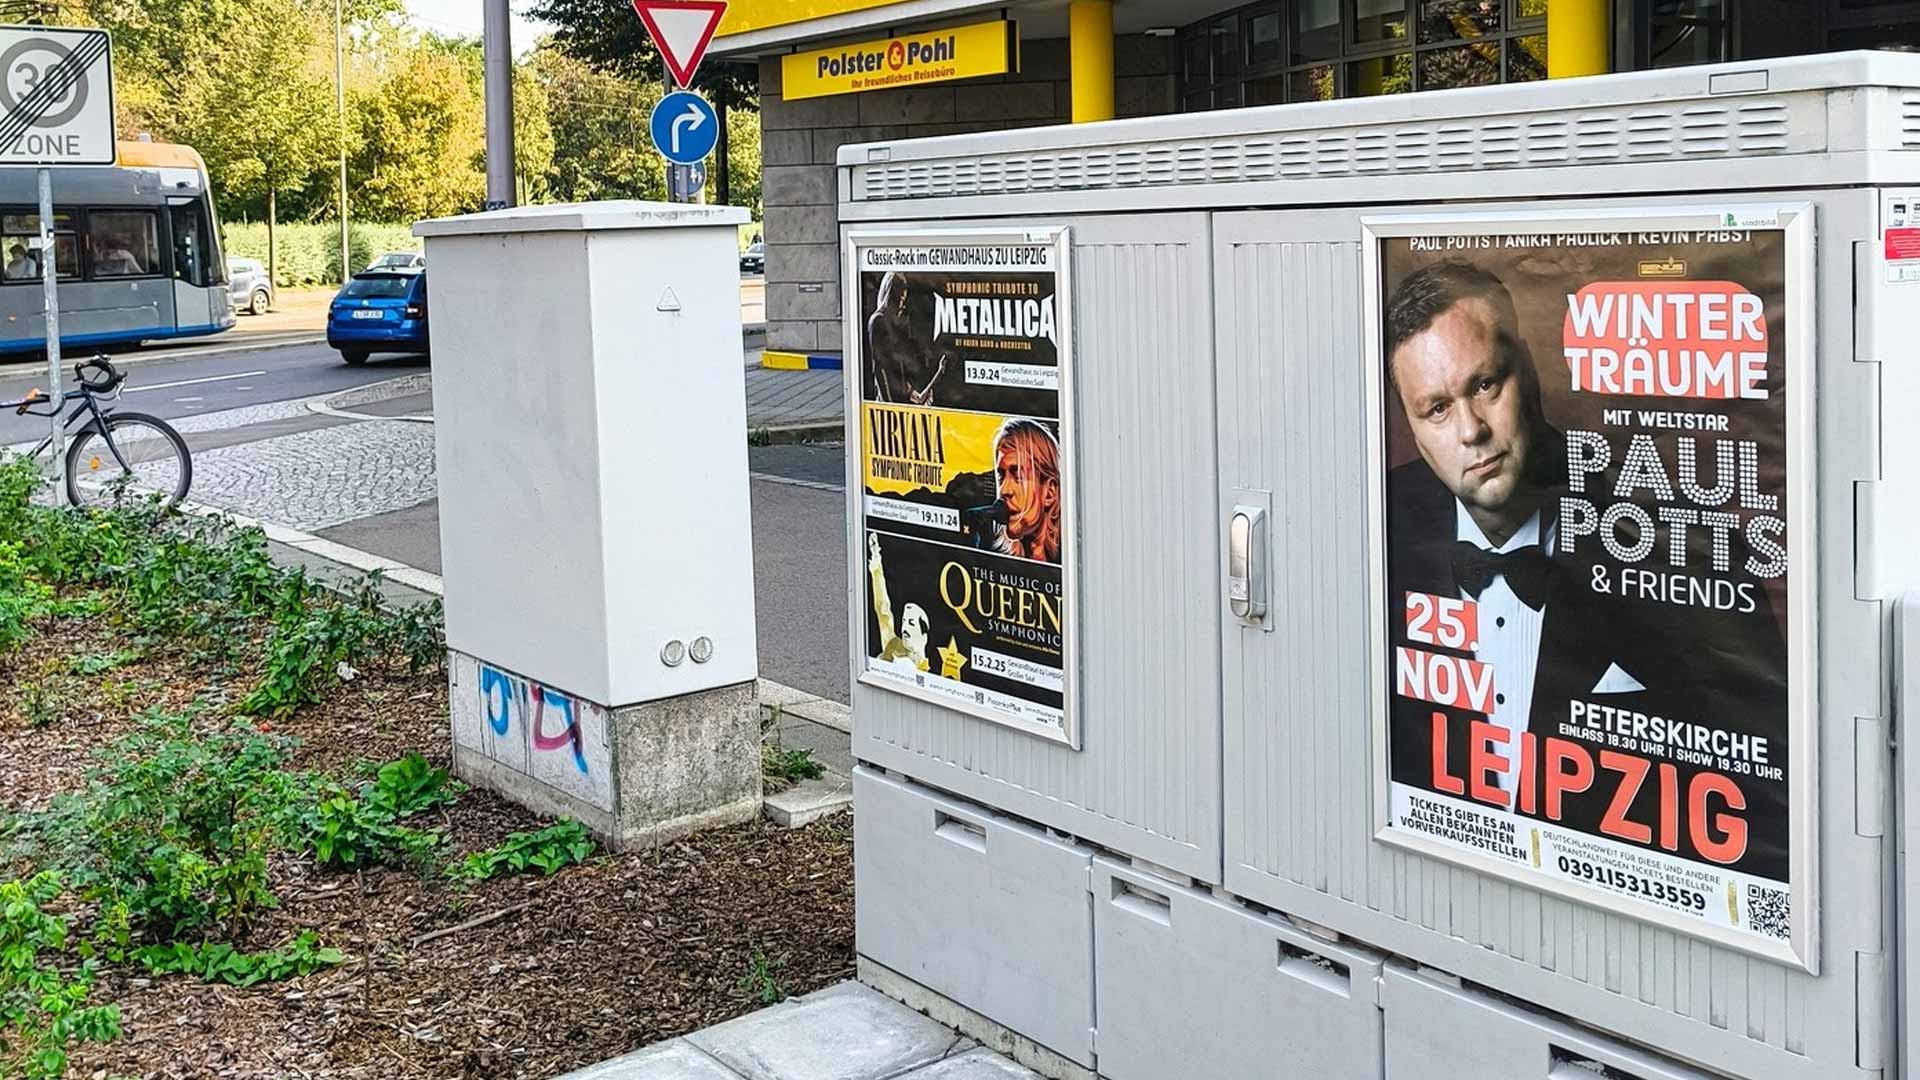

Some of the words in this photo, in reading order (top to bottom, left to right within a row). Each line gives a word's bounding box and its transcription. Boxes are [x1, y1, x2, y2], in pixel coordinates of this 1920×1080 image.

[817, 51, 885, 78] Polster
[907, 36, 955, 65] Pohl
[851, 78, 863, 88] Ihr
[864, 73, 912, 88] freundliches
[914, 66, 956, 83] Reisebüro
[12, 134, 80, 155] ZONE
[867, 249, 916, 265] Classic-Rock
[916, 249, 927, 265] im
[928, 248, 994, 265] GEWANDHAUS
[995, 248, 1008, 264] ZU
[1010, 247, 1047, 264] LEIPZIG
[1410, 236, 1442, 250] PAUL
[1447, 236, 1490, 249] POTTS
[1505, 234, 1550, 248] ANIKA
[1556, 232, 1621, 246] PAULICK
[1638, 231, 1689, 244] KEVIN
[1696, 230, 1750, 243] PABST
[946, 282, 991, 293] SYMPHONIC
[992, 283, 1025, 294] TRIBUTE
[1028, 283, 1039, 294] TO
[933, 291, 1058, 349] METALLICA
[1567, 294, 1764, 341] WINTER
[967, 368, 1000, 380] 13.9.24
[1564, 338, 1769, 399] TRÄUME
[869, 408, 946, 464] NIRVANA
[1603, 409, 1632, 426] MIT
[1638, 411, 1729, 432] WELTSTAR
[872, 458, 912, 482] SYMPHONIC
[914, 463, 943, 486] TRIBUTE
[1567, 430, 1778, 510] PAUL
[921, 511, 958, 526] 19.11.24
[1560, 497, 1788, 578] POTTS
[940, 561, 1062, 634] QUEEN
[973, 567, 994, 580] THE
[1000, 573, 1040, 590] MUSIC
[1045, 583, 1060, 595] OF
[1591, 564, 1612, 594] &
[1621, 568, 1756, 613] FRIENDS
[988, 620, 1061, 647] SYMPHONIC
[1406, 592, 1479, 651] 25.
[973, 654, 1006, 672] 15.2.25
[1559, 722, 1604, 743] EINLASS
[1607, 733, 1636, 750] 18.30
[1641, 741, 1664, 757] UHR
[1676, 749, 1713, 767] SHOW
[1717, 757, 1750, 775] 19.30
[1755, 765, 1783, 781] UHR
[1570, 700, 1768, 764] PETERSKIRCHE
[1432, 712, 1748, 864] LEIPZIG
[1409, 796, 1452, 816] TICKETS
[1455, 809, 1480, 823] GIBT
[1483, 816, 1497, 828] ES
[1500, 821, 1515, 833] AN
[1411, 808, 1443, 826] ALLEN
[1447, 817, 1514, 845] BEKANNTEN
[1400, 816, 1527, 860] VORVERKAUFSSTELLEN
[1543, 831, 1618, 856] DEUTSCHLANDWEIT
[1620, 849, 1636, 862] FÜR
[1638, 856, 1661, 869] DIESE
[1663, 864, 1683, 874] UND
[1685, 869, 1720, 885] ANDERE
[1552, 843, 1629, 870] VERANSTALTUNGEN
[1632, 864, 1663, 880] TICKETS
[1665, 874, 1714, 893] BESTELLEN
